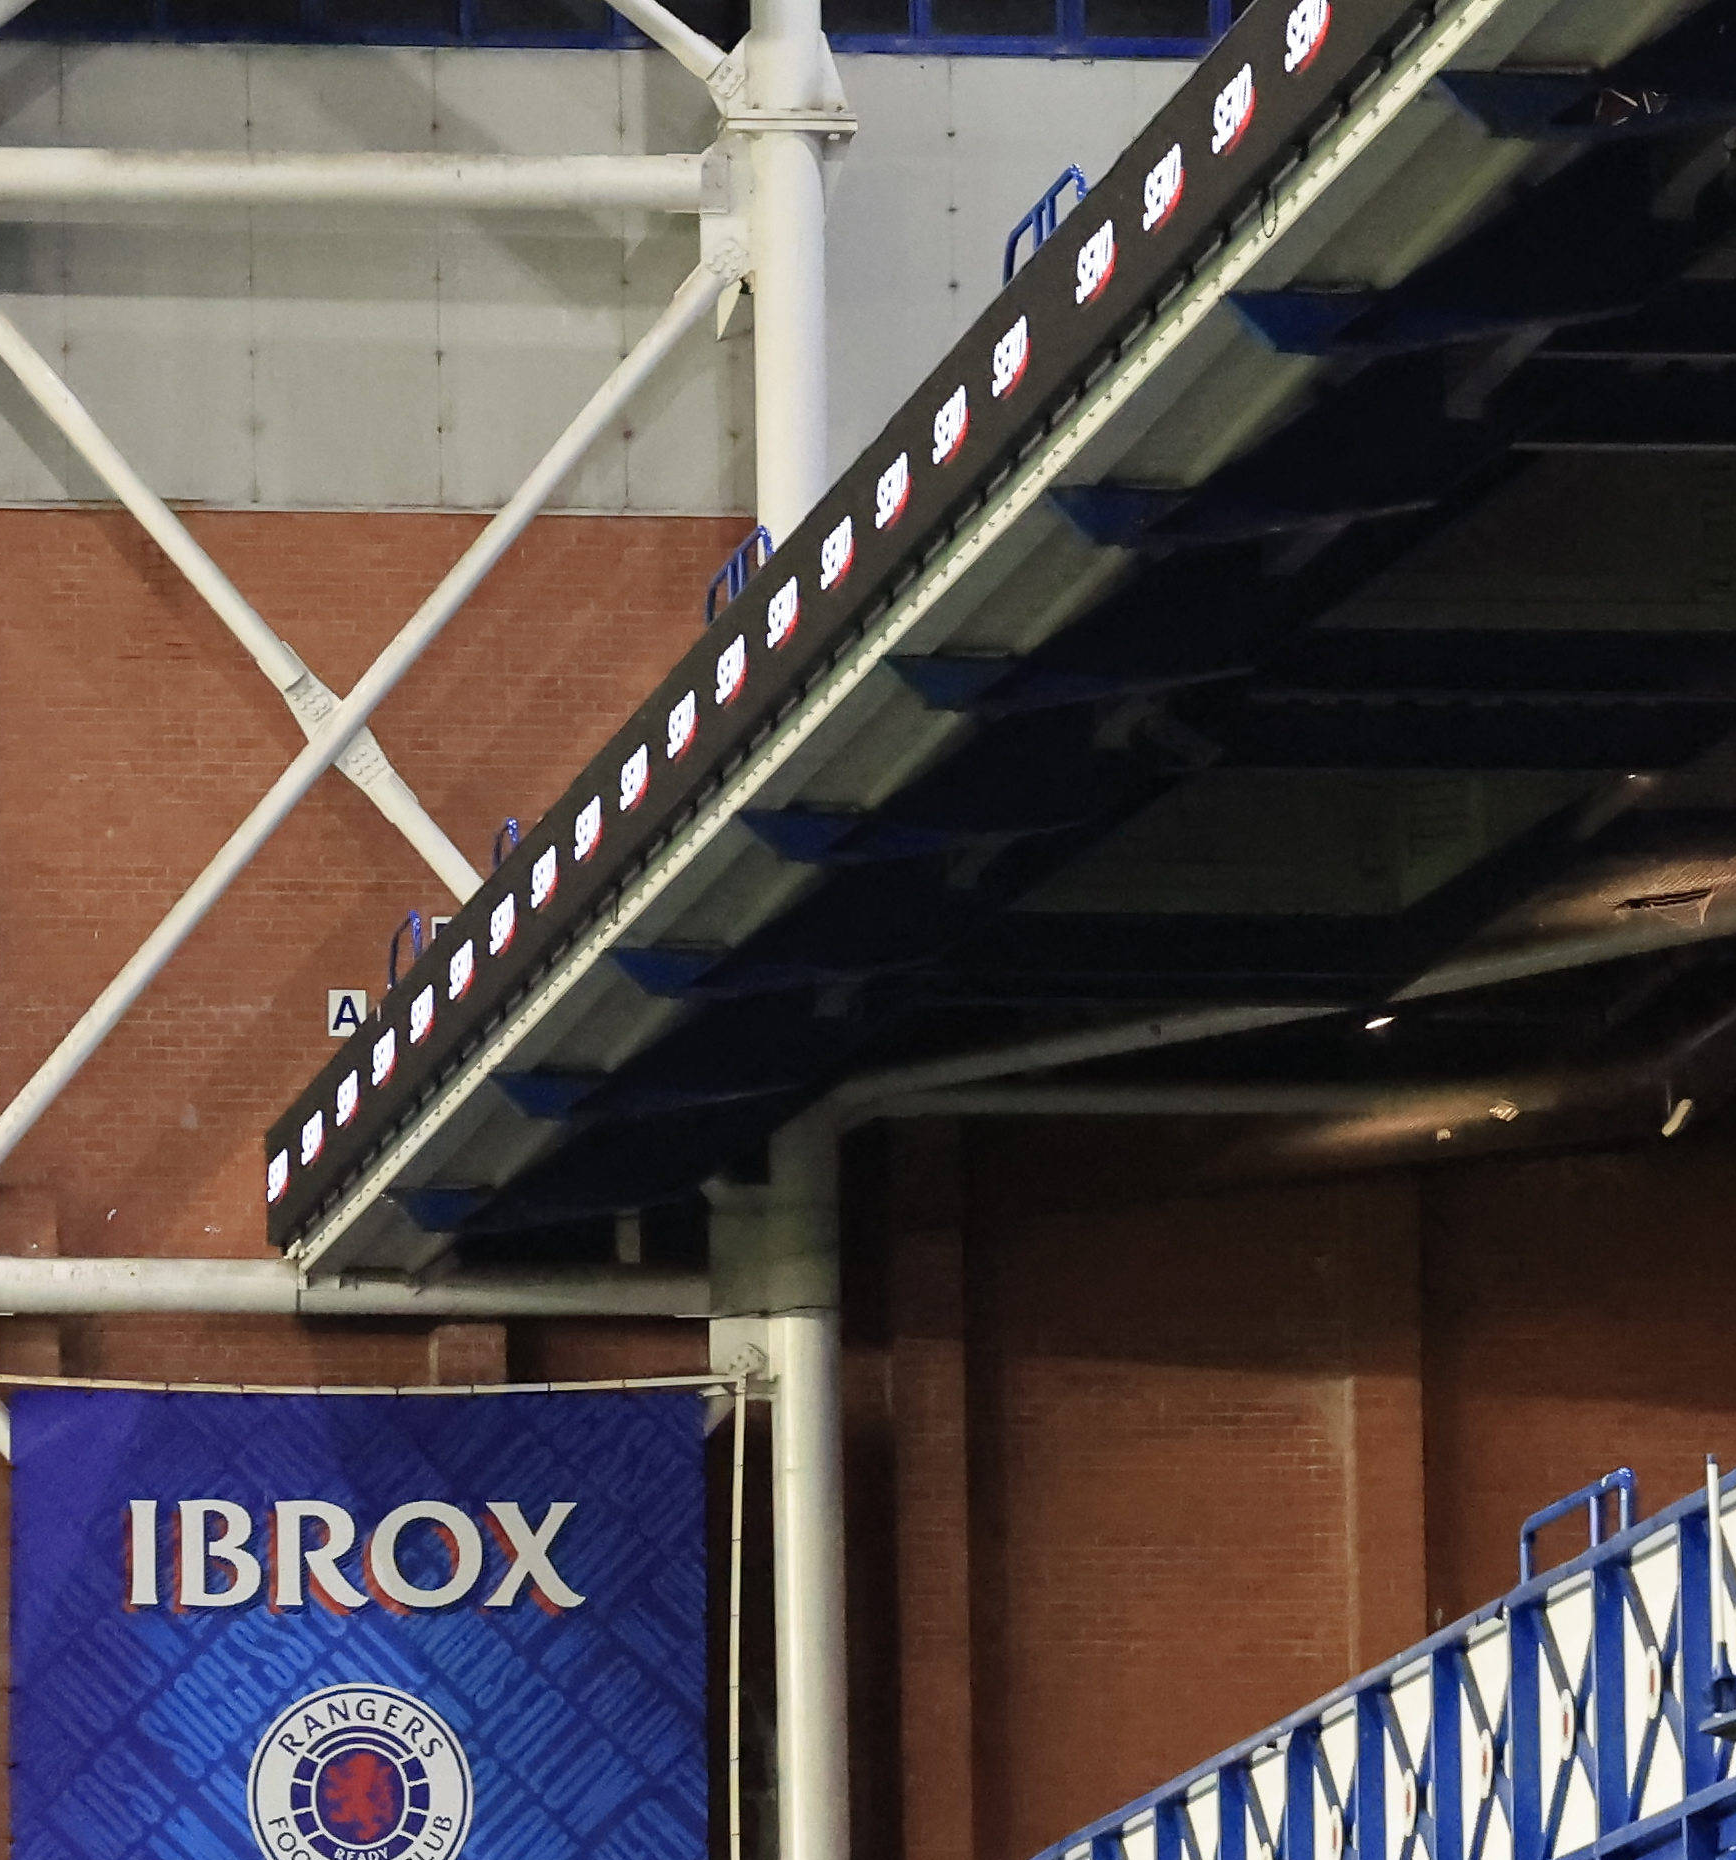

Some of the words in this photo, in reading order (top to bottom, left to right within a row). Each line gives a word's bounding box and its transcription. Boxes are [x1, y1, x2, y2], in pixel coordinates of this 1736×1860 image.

[332, 996, 361, 1030] A
[126, 1499, 587, 1610] IBROX
[278, 1698, 443, 1758] RANGERS
